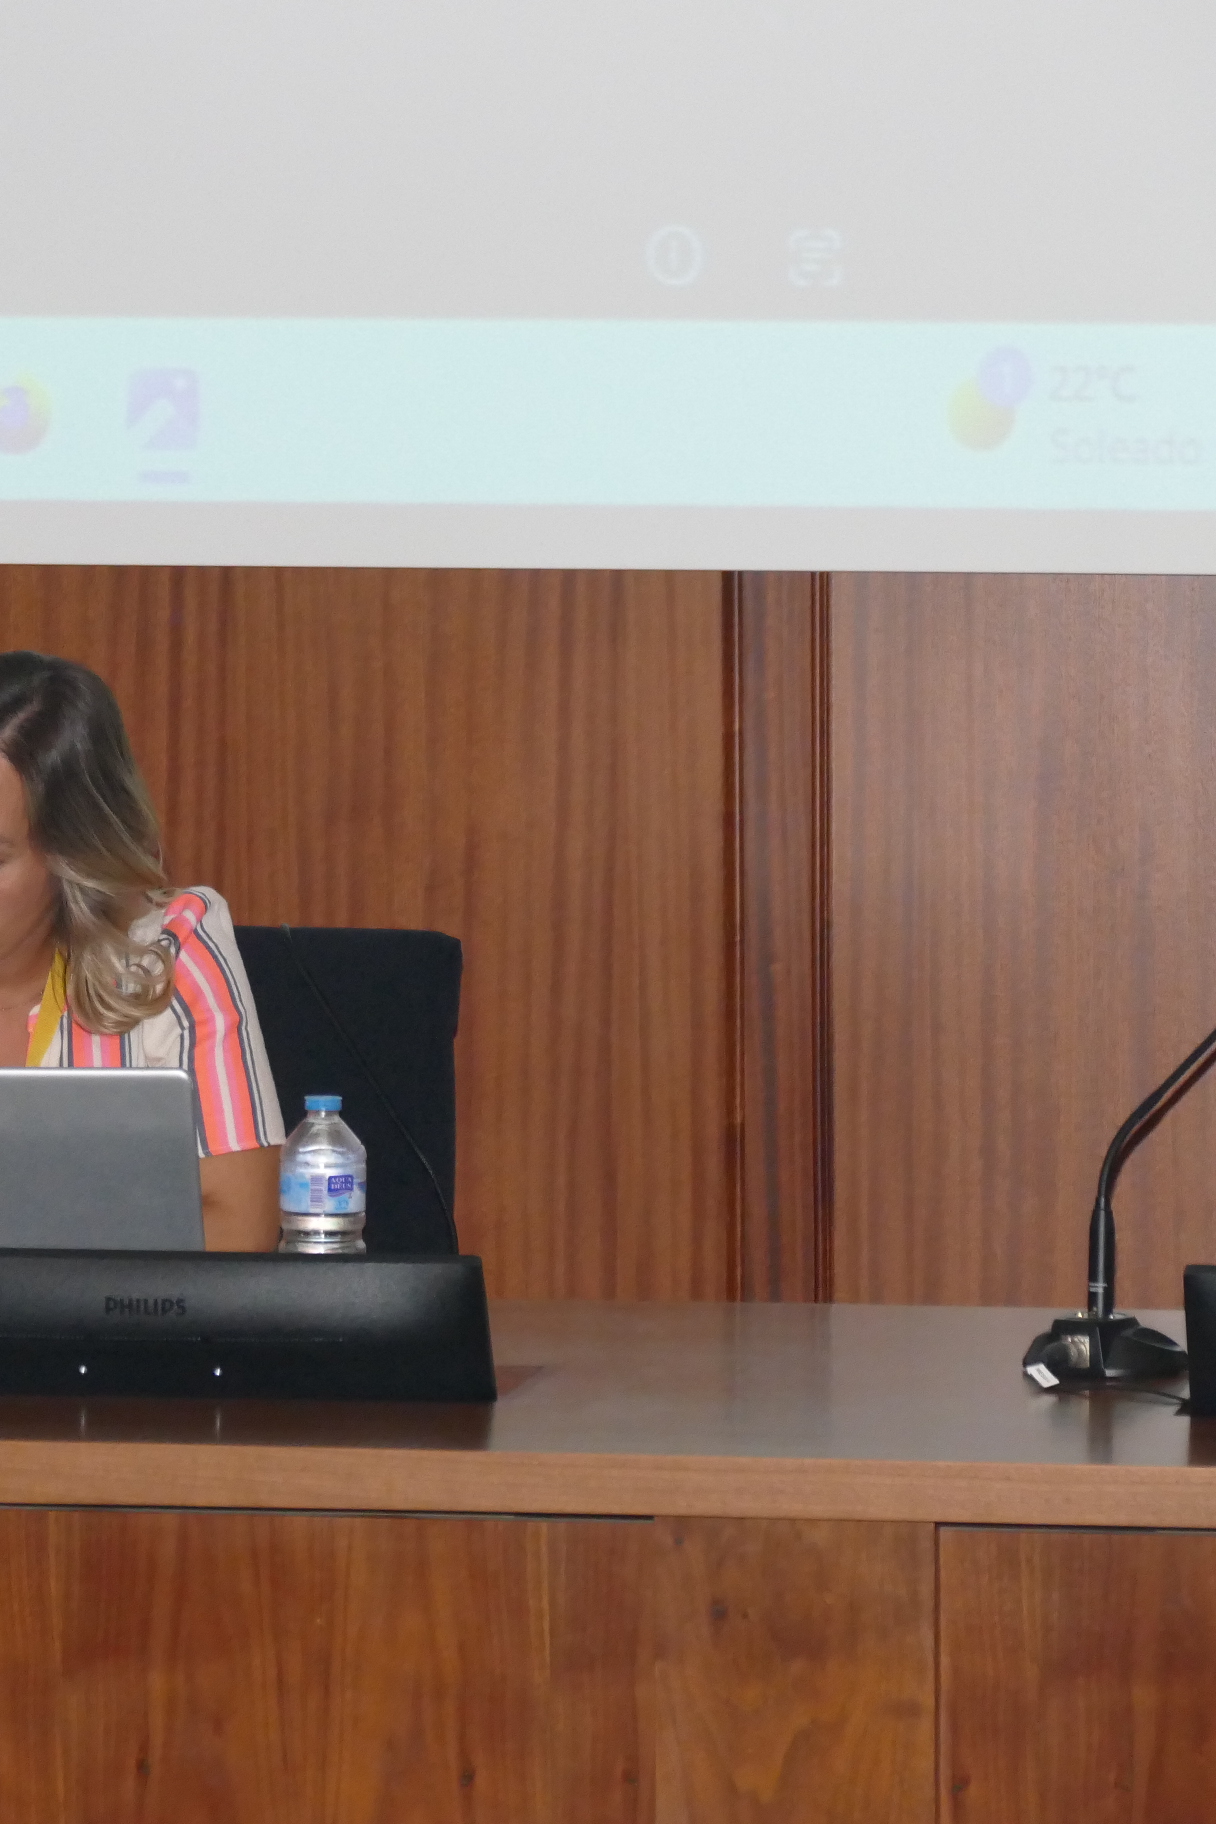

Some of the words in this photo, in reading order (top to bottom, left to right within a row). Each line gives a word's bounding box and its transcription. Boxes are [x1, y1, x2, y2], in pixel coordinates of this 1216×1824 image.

[1049, 363, 1140, 403] 22°C
[1050, 428, 1202, 466] Soleado
[331, 1176, 352, 1184] AQUA
[104, 1296, 187, 1315] PHILIPS
